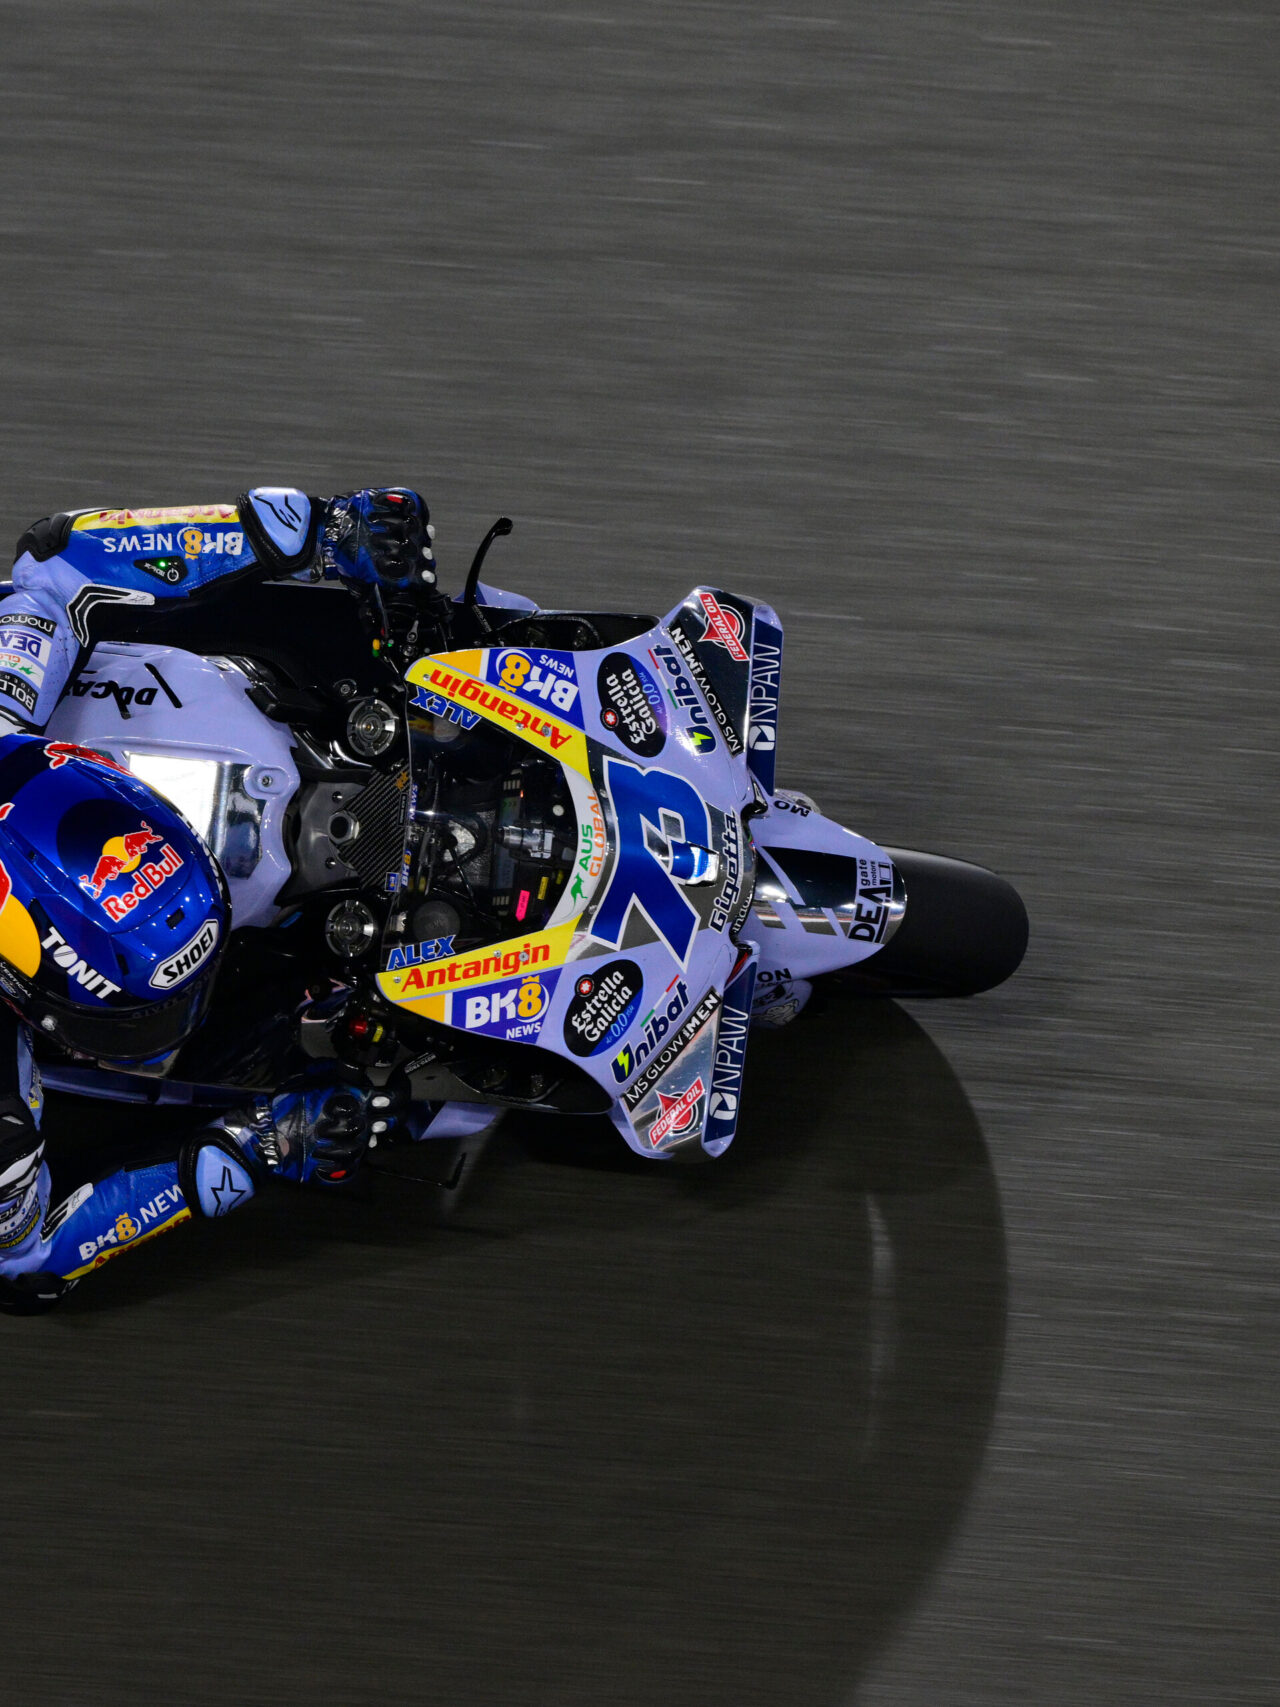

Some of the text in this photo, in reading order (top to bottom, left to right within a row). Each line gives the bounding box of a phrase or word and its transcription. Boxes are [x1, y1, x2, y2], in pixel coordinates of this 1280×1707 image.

[102, 527, 244, 560] BK8 NEWS
[703, 596, 746, 660] FEDERAL OIL
[70, 680, 159, 706] DUCA
[497, 650, 579, 713] BK8
[539, 654, 575, 679] NEWS
[751, 642, 781, 723] NPAW
[408, 683, 482, 730] ALEX
[429, 668, 574, 751] Antangin
[606, 672, 647, 744] Estrella
[621, 668, 657, 735] Galicia
[651, 643, 717, 755] Unibat
[697, 677, 727, 724] GLOW
[723, 726, 742, 752] MS
[579, 824, 594, 871] AUS
[586, 790, 606, 878] GLOBAL
[858, 858, 870, 887] gate
[41, 926, 122, 1000] TONIT
[161, 926, 215, 985] SHOEI
[387, 934, 456, 971] ALEX
[401, 942, 551, 992] Antangin
[464, 975, 550, 1029] BK8
[505, 1021, 542, 1040] NEWS
[571, 970, 625, 1035] Estrella
[584, 986, 633, 1042] Galicia
[609, 978, 691, 1085] Unibat
[626, 1079, 650, 1104] MS
[647, 1034, 684, 1080] GLOW
[712, 1004, 749, 1092] NPAW
[652, 1085, 701, 1141] FEDERAL OIL
[79, 1212, 141, 1261] BK8
[139, 1184, 184, 1224] NEW
